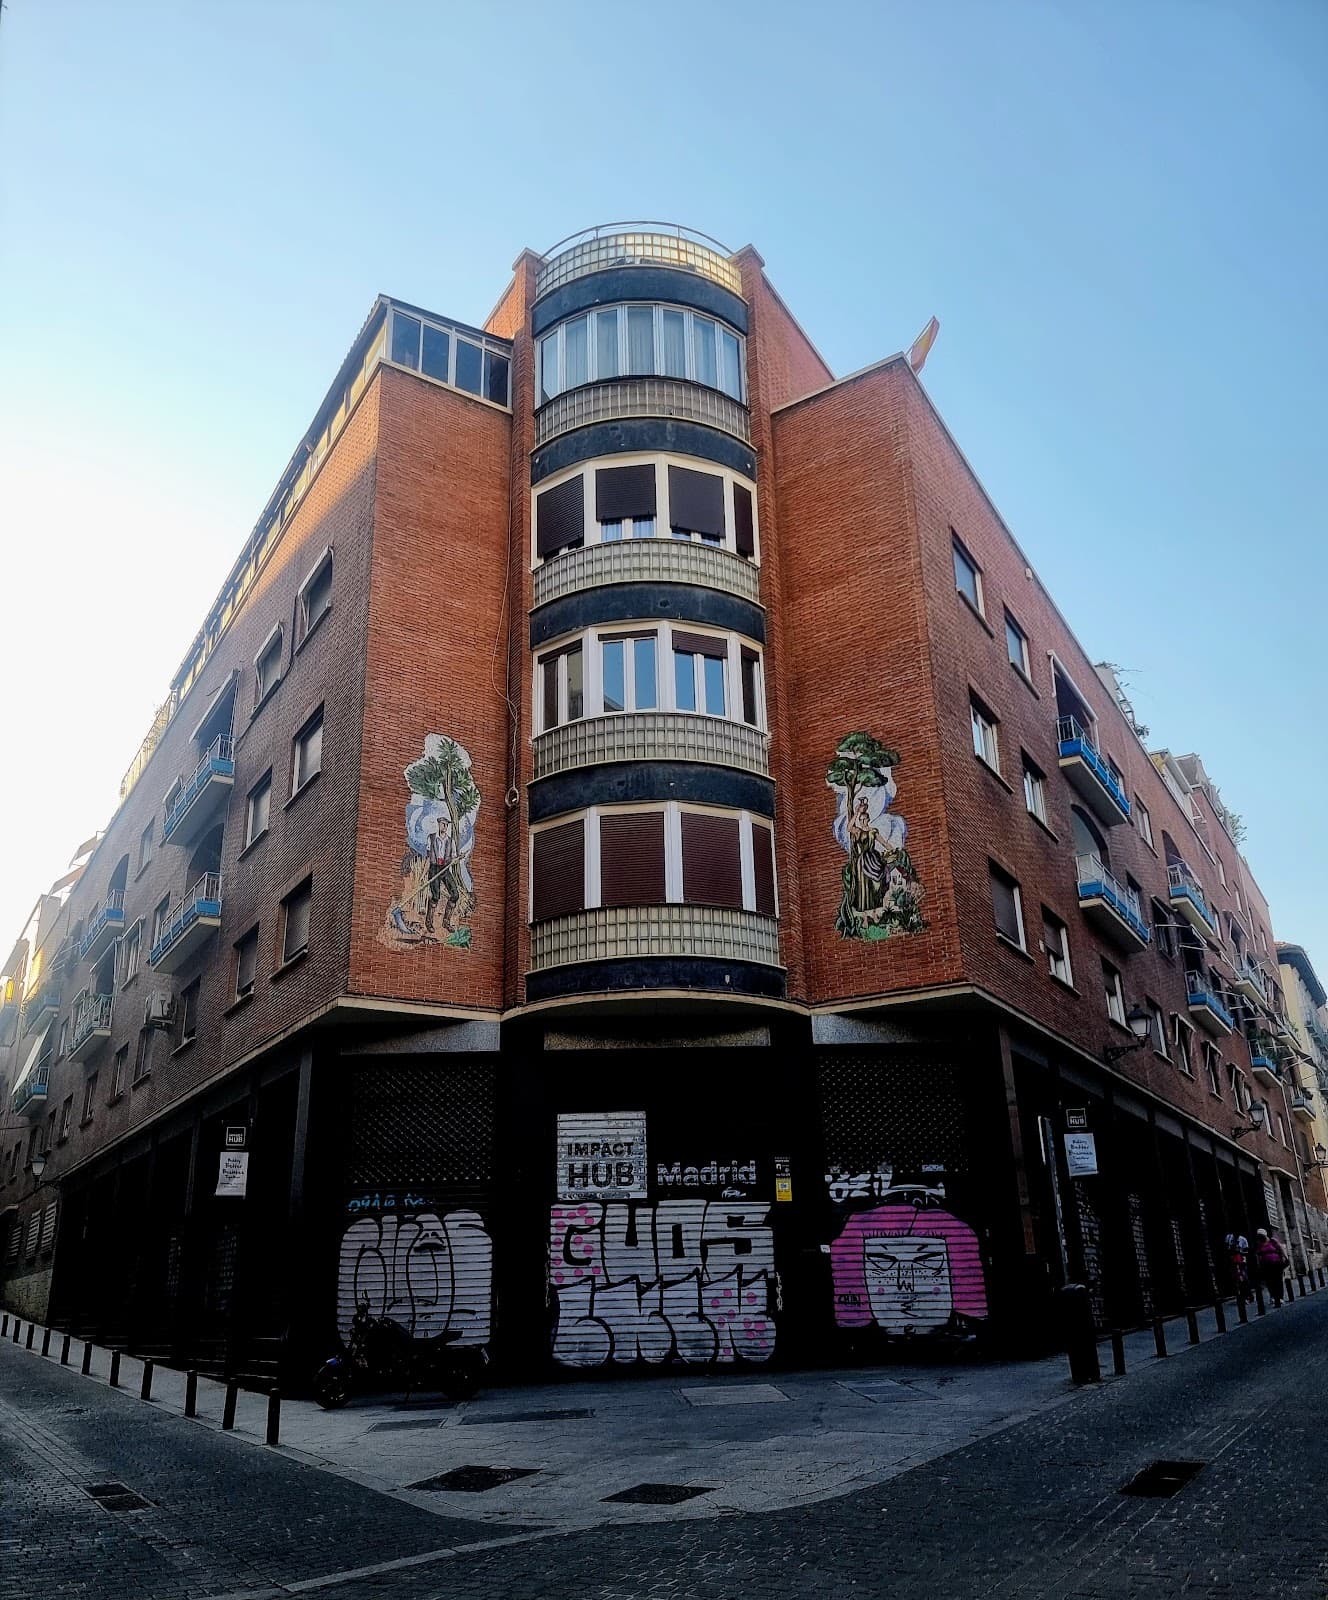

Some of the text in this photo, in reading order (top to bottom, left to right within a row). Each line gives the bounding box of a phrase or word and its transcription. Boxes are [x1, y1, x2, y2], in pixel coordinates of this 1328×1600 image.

[567, 1142, 634, 1156] IMPACT
[567, 1162, 634, 1187] HUB
[656, 1160, 757, 1186] Madrid
